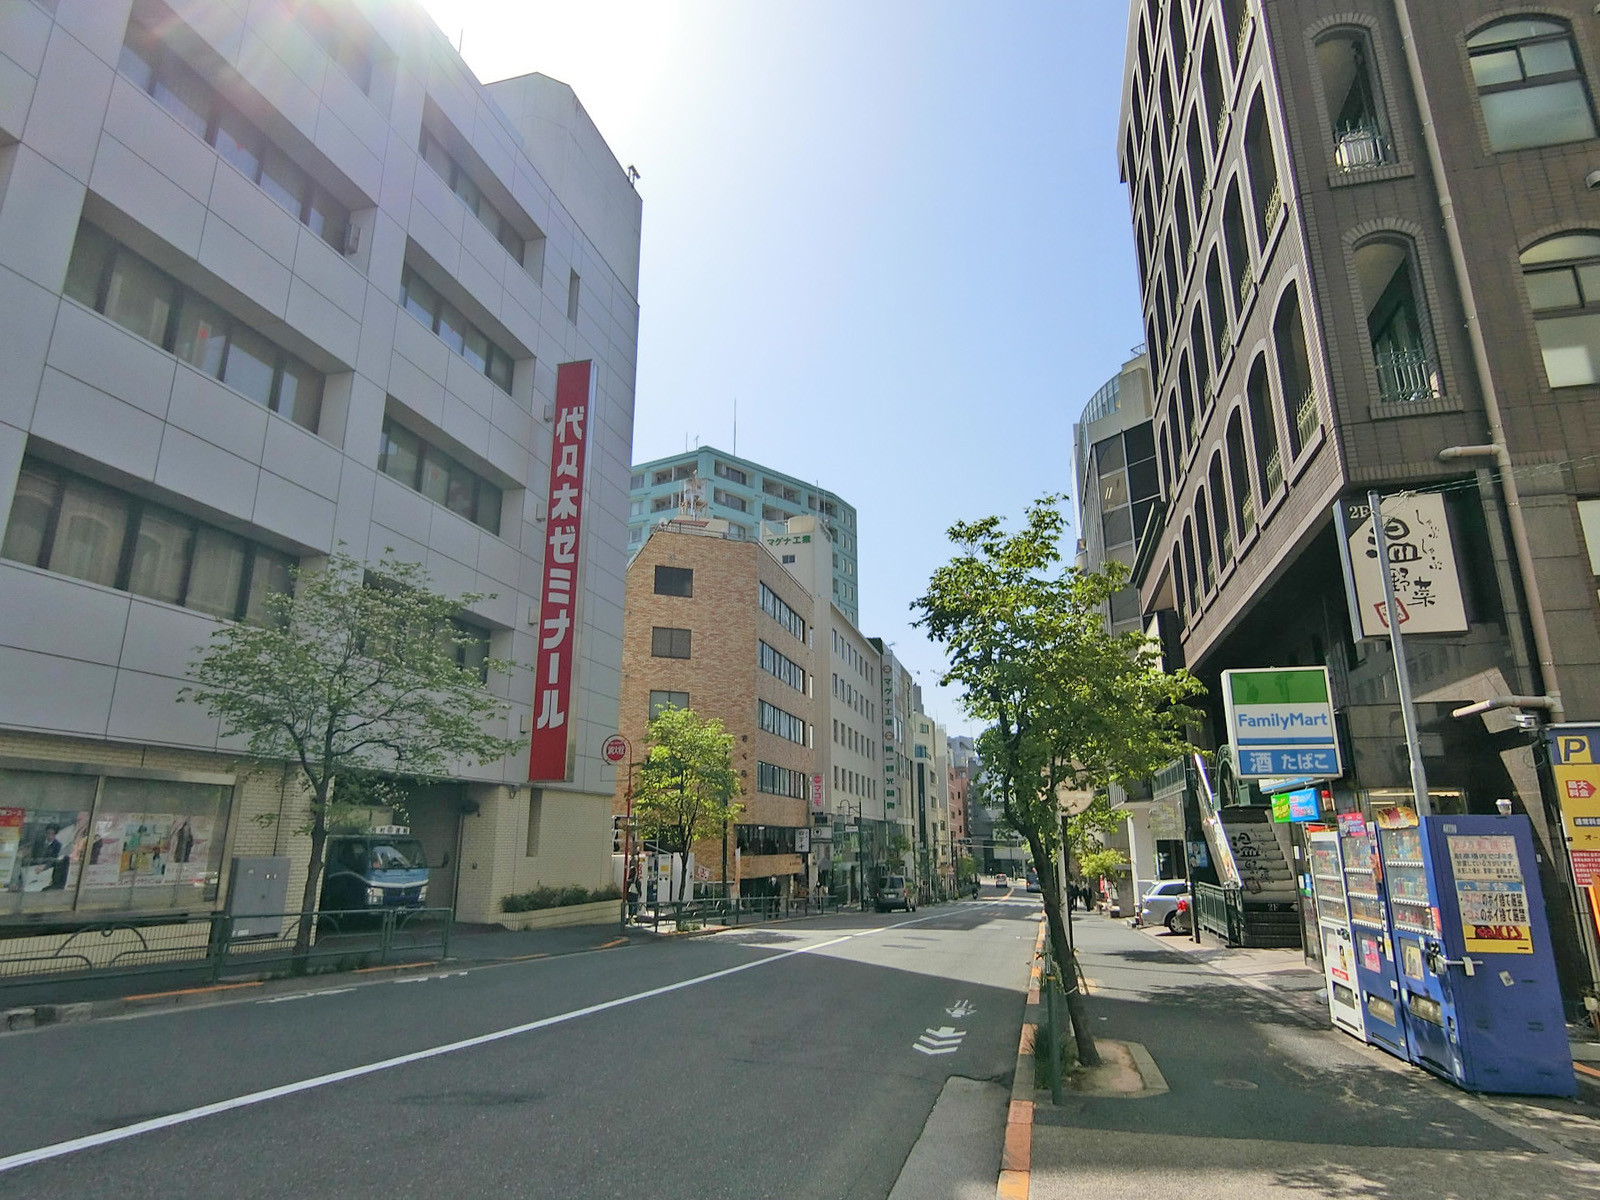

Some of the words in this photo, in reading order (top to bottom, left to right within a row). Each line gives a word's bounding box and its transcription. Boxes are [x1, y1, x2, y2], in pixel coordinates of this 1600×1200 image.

[767, 535, 811, 546] マグナ工業
[536, 405, 585, 730] 代々木ゼミナール
[1238, 713, 1328, 730] FamilyMart
[1564, 739, 1586, 761] P
[1250, 752, 1273, 773] 酒
[1281, 753, 1329, 770] たばこ
[1569, 789, 1590, 797] 料金
